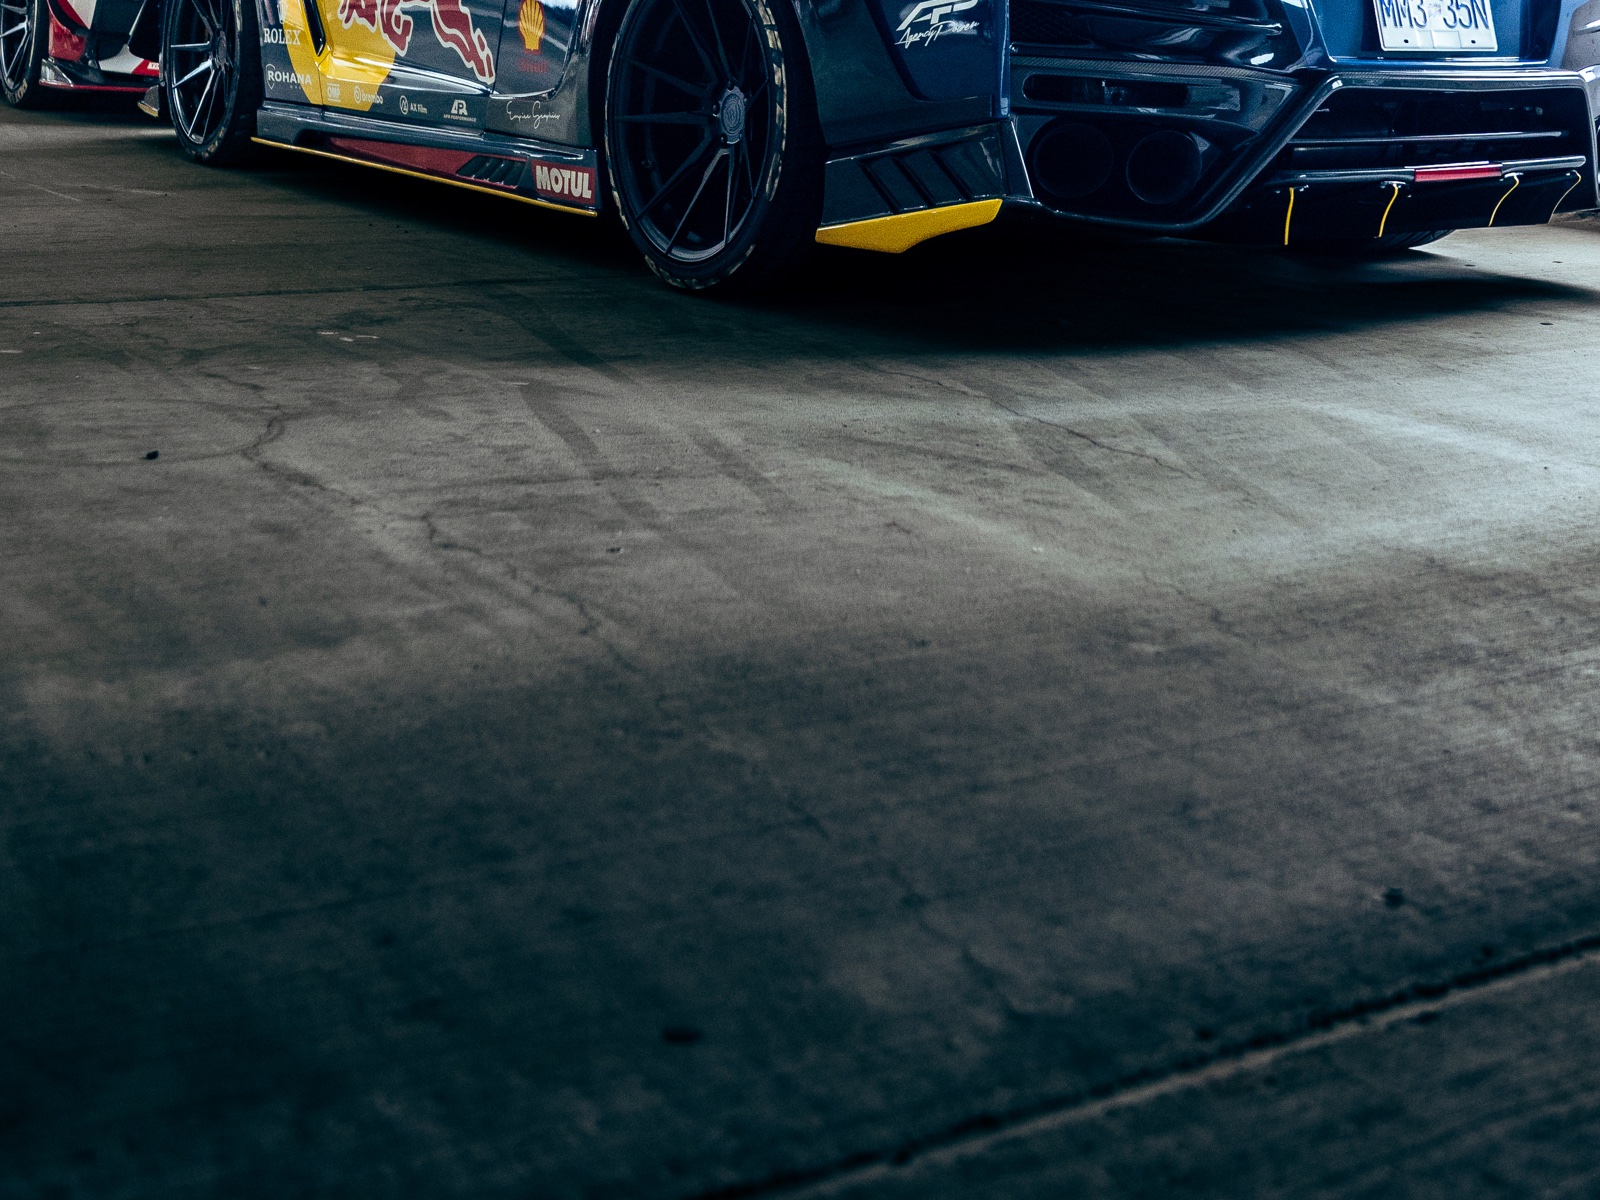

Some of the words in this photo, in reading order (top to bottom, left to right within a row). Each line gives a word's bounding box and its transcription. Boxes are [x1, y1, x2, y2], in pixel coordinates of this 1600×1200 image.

[263, 27, 301, 46] ROLEX
[267, 70, 313, 86] ROHANA
[535, 165, 592, 199] MOTUL
